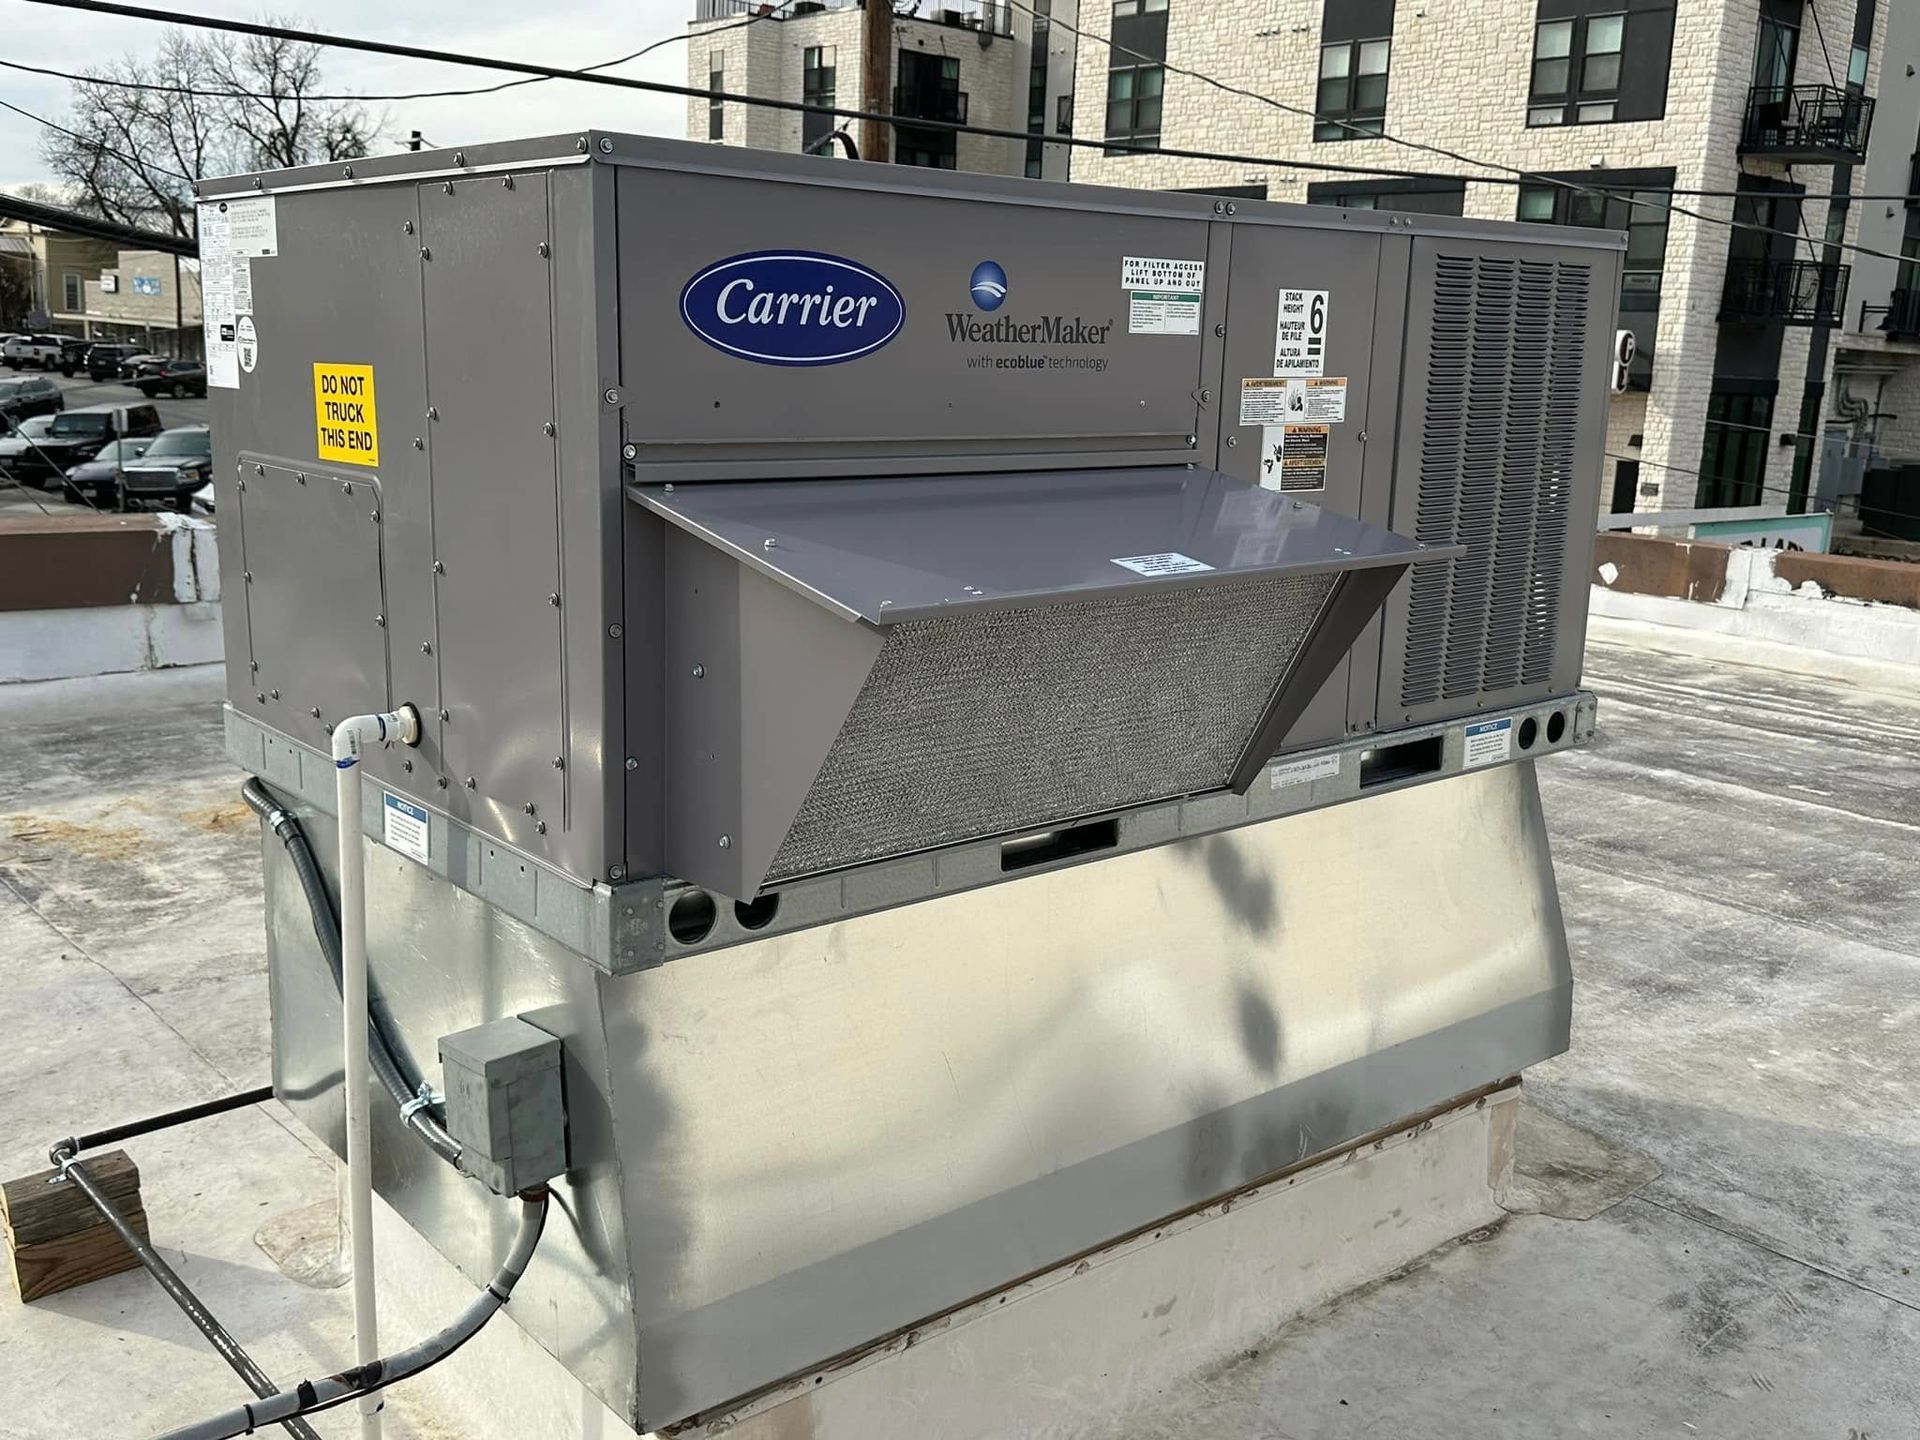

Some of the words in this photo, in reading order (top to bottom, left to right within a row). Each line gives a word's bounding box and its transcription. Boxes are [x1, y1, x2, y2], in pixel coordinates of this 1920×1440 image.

[1143, 261, 1170, 270] FILTER
[1174, 263, 1203, 271] ACCESS
[1152, 270, 1183, 278] BOTTOM
[1125, 277, 1150, 285] PANEL
[1285, 292, 1304, 302] STACK
[716, 278, 878, 328] Carrier
[1283, 304, 1304, 314] HEIGHT
[1310, 294, 1324, 335] 6
[1280, 321, 1306, 331] HAUTEUR
[1281, 331, 1289, 341] DE
[1290, 331, 1303, 341] PILE
[1280, 348, 1301, 357] ALTURA
[967, 355, 993, 369] with
[1049, 356, 1109, 372] technology
[1276, 359, 1284, 368] DE
[1284, 359, 1320, 369] APILAMIENTO
[322, 374, 338, 394] DO
[341, 375, 365, 396] NOT
[325, 401, 365, 424] TRUCK
[321, 427, 345, 448] THIS
[348, 430, 373, 451] END
